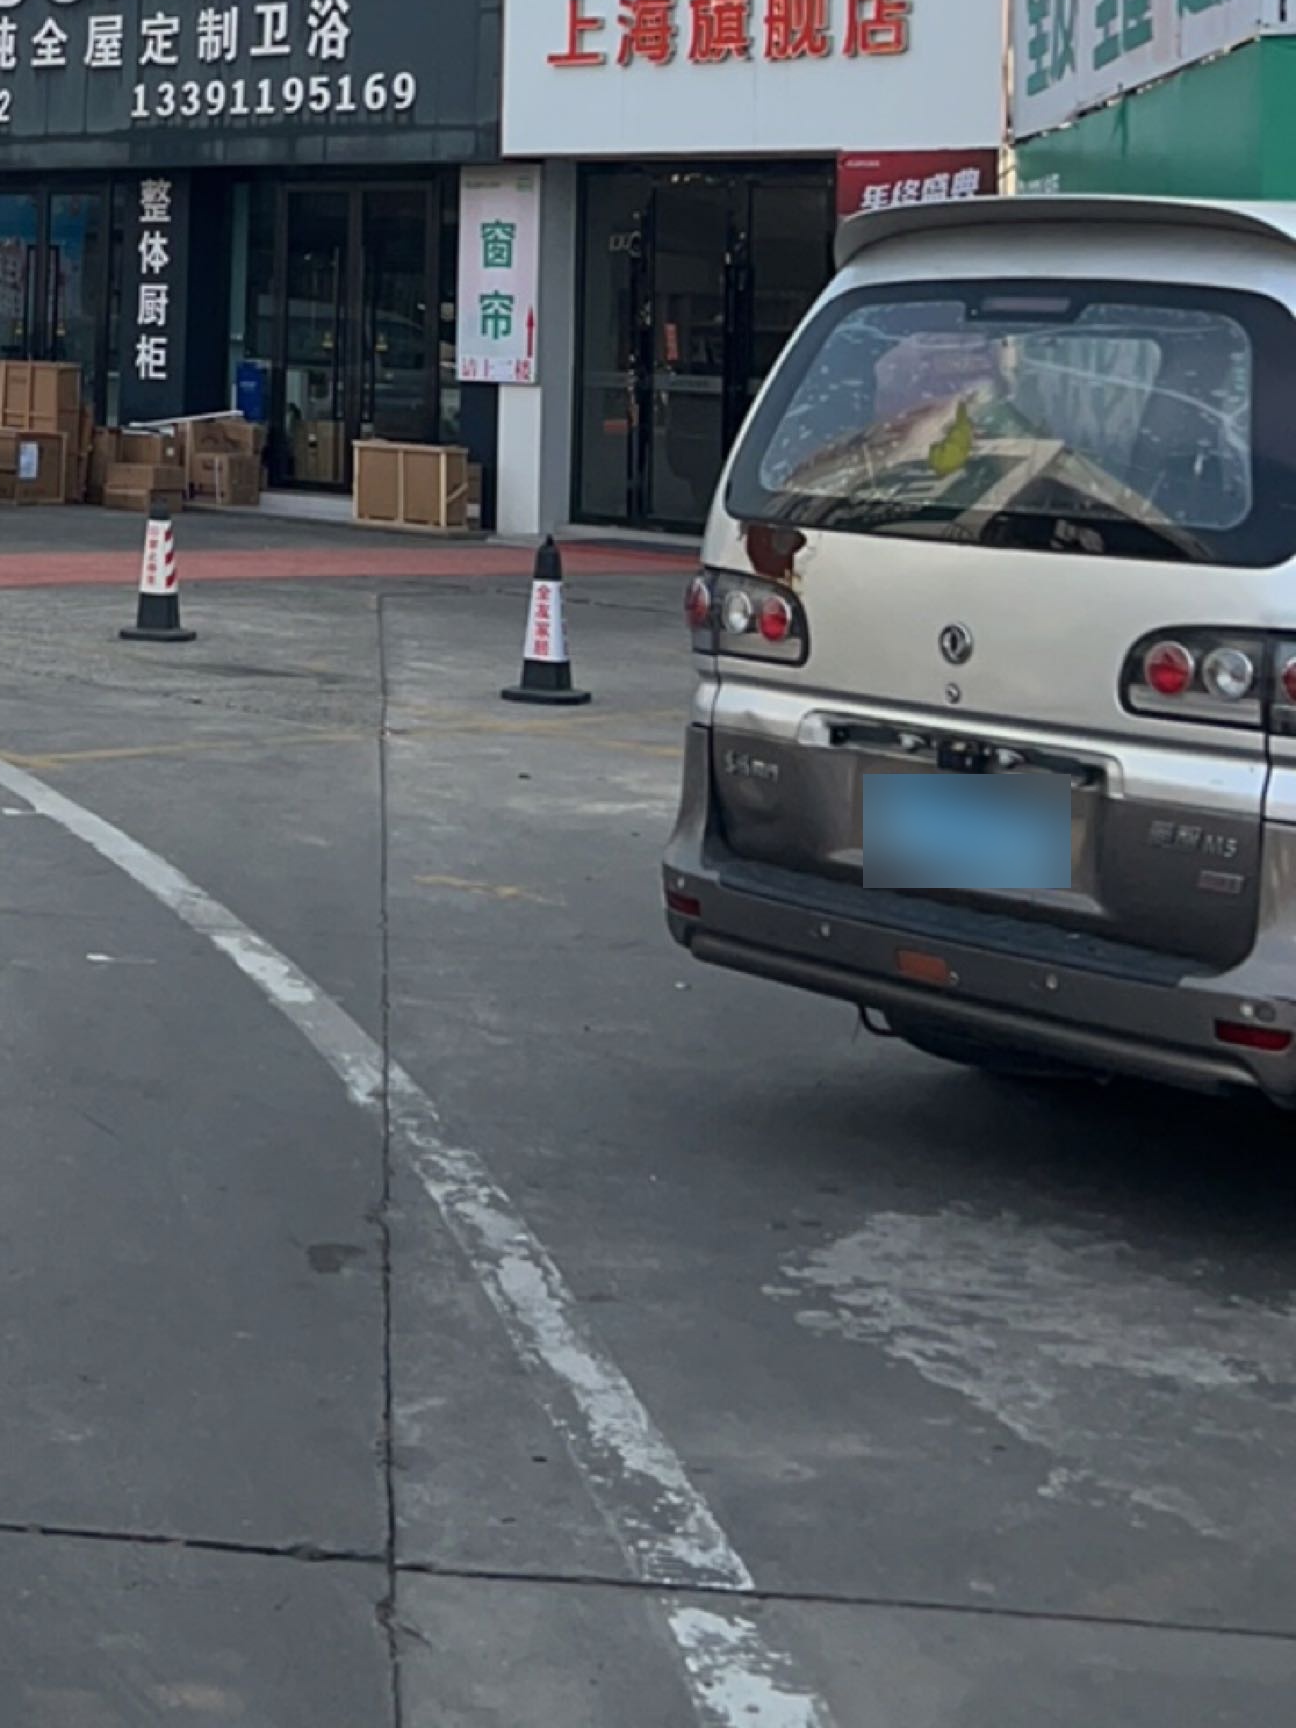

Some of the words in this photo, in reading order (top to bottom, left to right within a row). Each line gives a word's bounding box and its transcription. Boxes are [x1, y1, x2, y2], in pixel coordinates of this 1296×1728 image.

[131, 72, 416, 118] 13391195169
[135, 177, 172, 381] 整体厨柜
[478, 218, 517, 341] 窗帘
